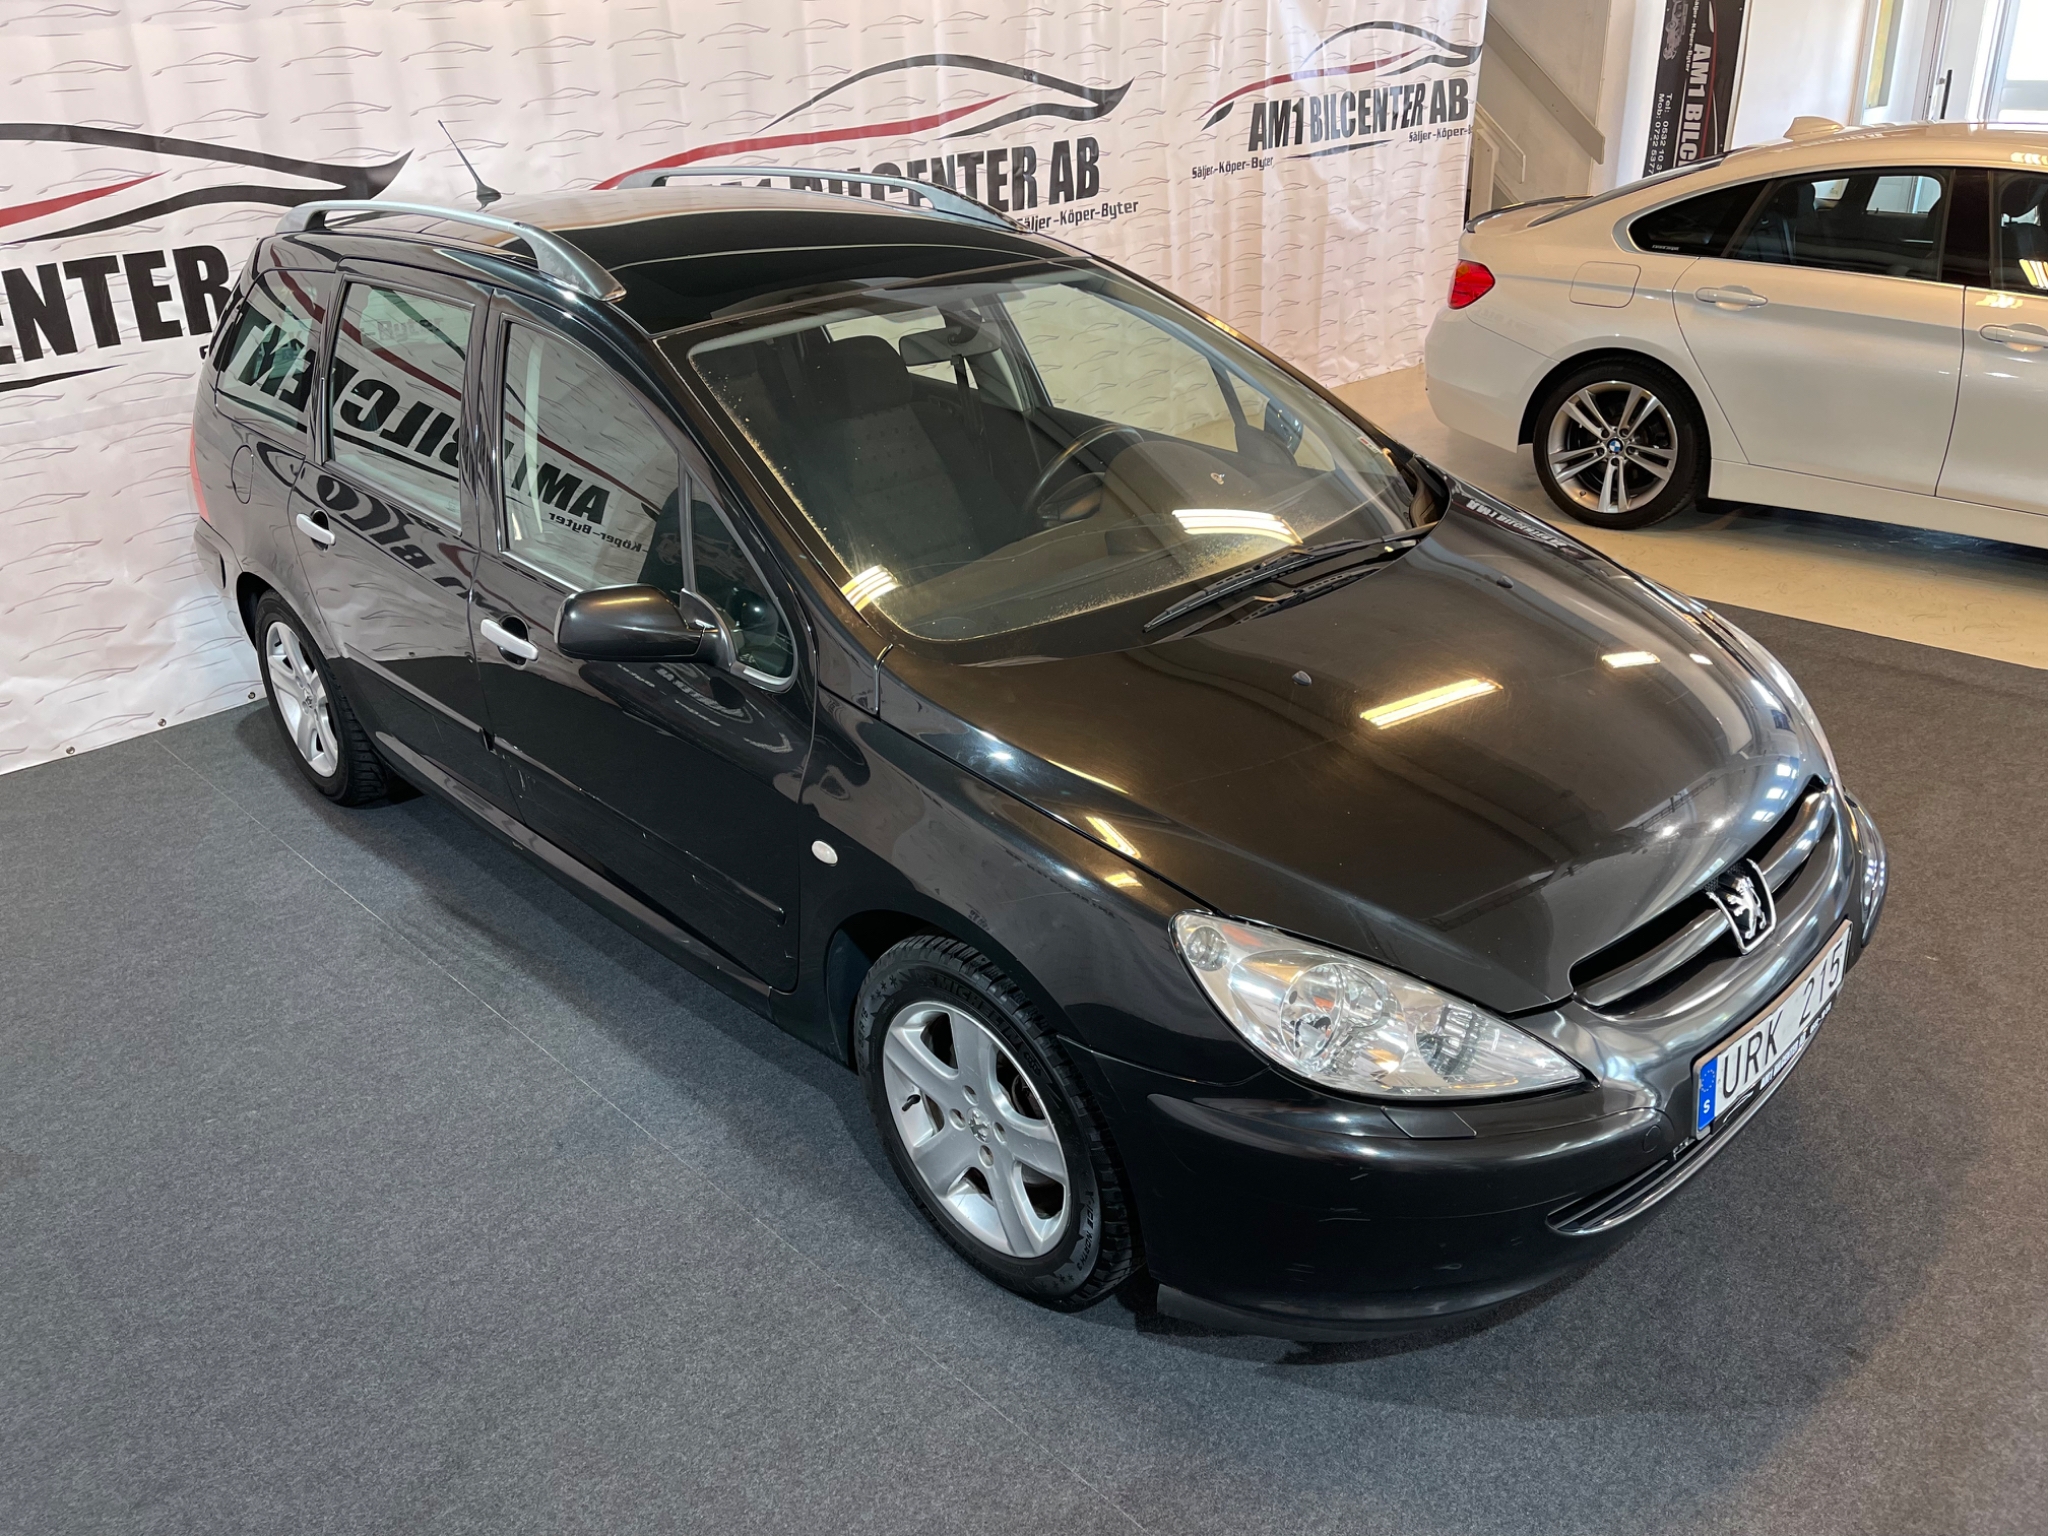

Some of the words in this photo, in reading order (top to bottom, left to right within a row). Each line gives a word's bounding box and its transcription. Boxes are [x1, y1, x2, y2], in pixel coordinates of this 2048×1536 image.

[1687, 43, 1712, 98] AM1
[1248, 97, 1304, 152] AM1
[1309, 82, 1426, 144] BILCENTER
[1429, 78, 1469, 125] AB
[1652, 121, 1661, 147] 0722
[1655, 93, 1665, 119] Mob:
[1664, 93, 1673, 113] Tel:
[1678, 104, 1704, 168] BILC
[1049, 136, 1100, 206] AB
[0, 245, 233, 366] NTER
[935, 976, 1024, 1050] MICHELIN
[1722, 1009, 1784, 1099] URK
[1799, 940, 1843, 1029] 215
[1702, 1098, 1711, 1114] S
